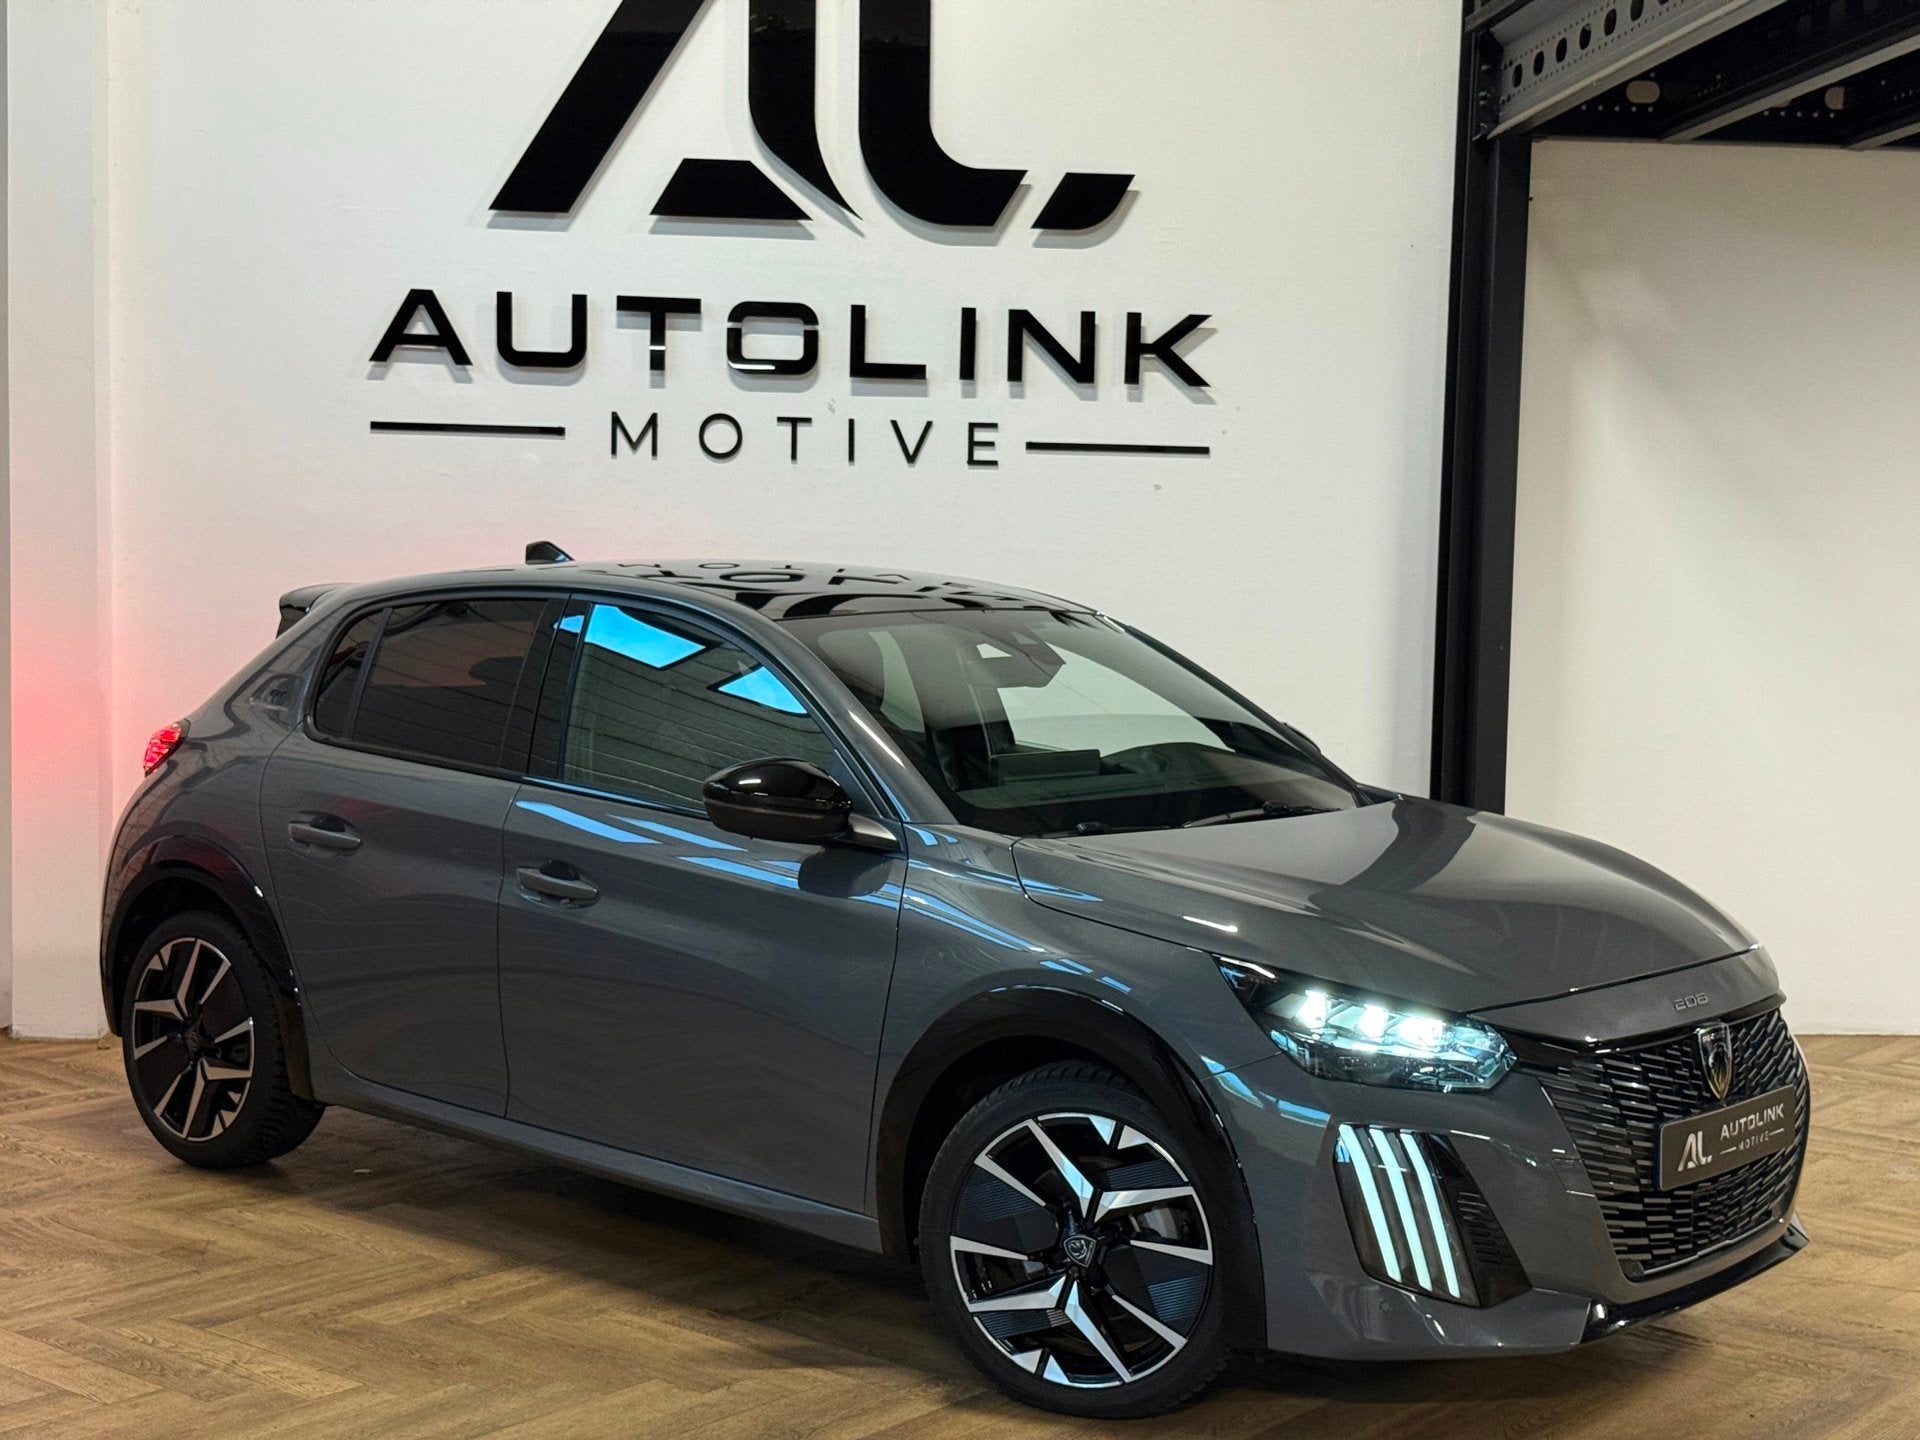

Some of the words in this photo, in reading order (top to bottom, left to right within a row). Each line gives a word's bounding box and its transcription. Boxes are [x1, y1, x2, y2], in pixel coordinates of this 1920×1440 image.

[369, 288, 1212, 388] AUTOLINK
[611, 411, 998, 466] MOTIVE
[1720, 1103, 1784, 1141] AUTOLINK
[1738, 1130, 1769, 1151] MOTIVE
